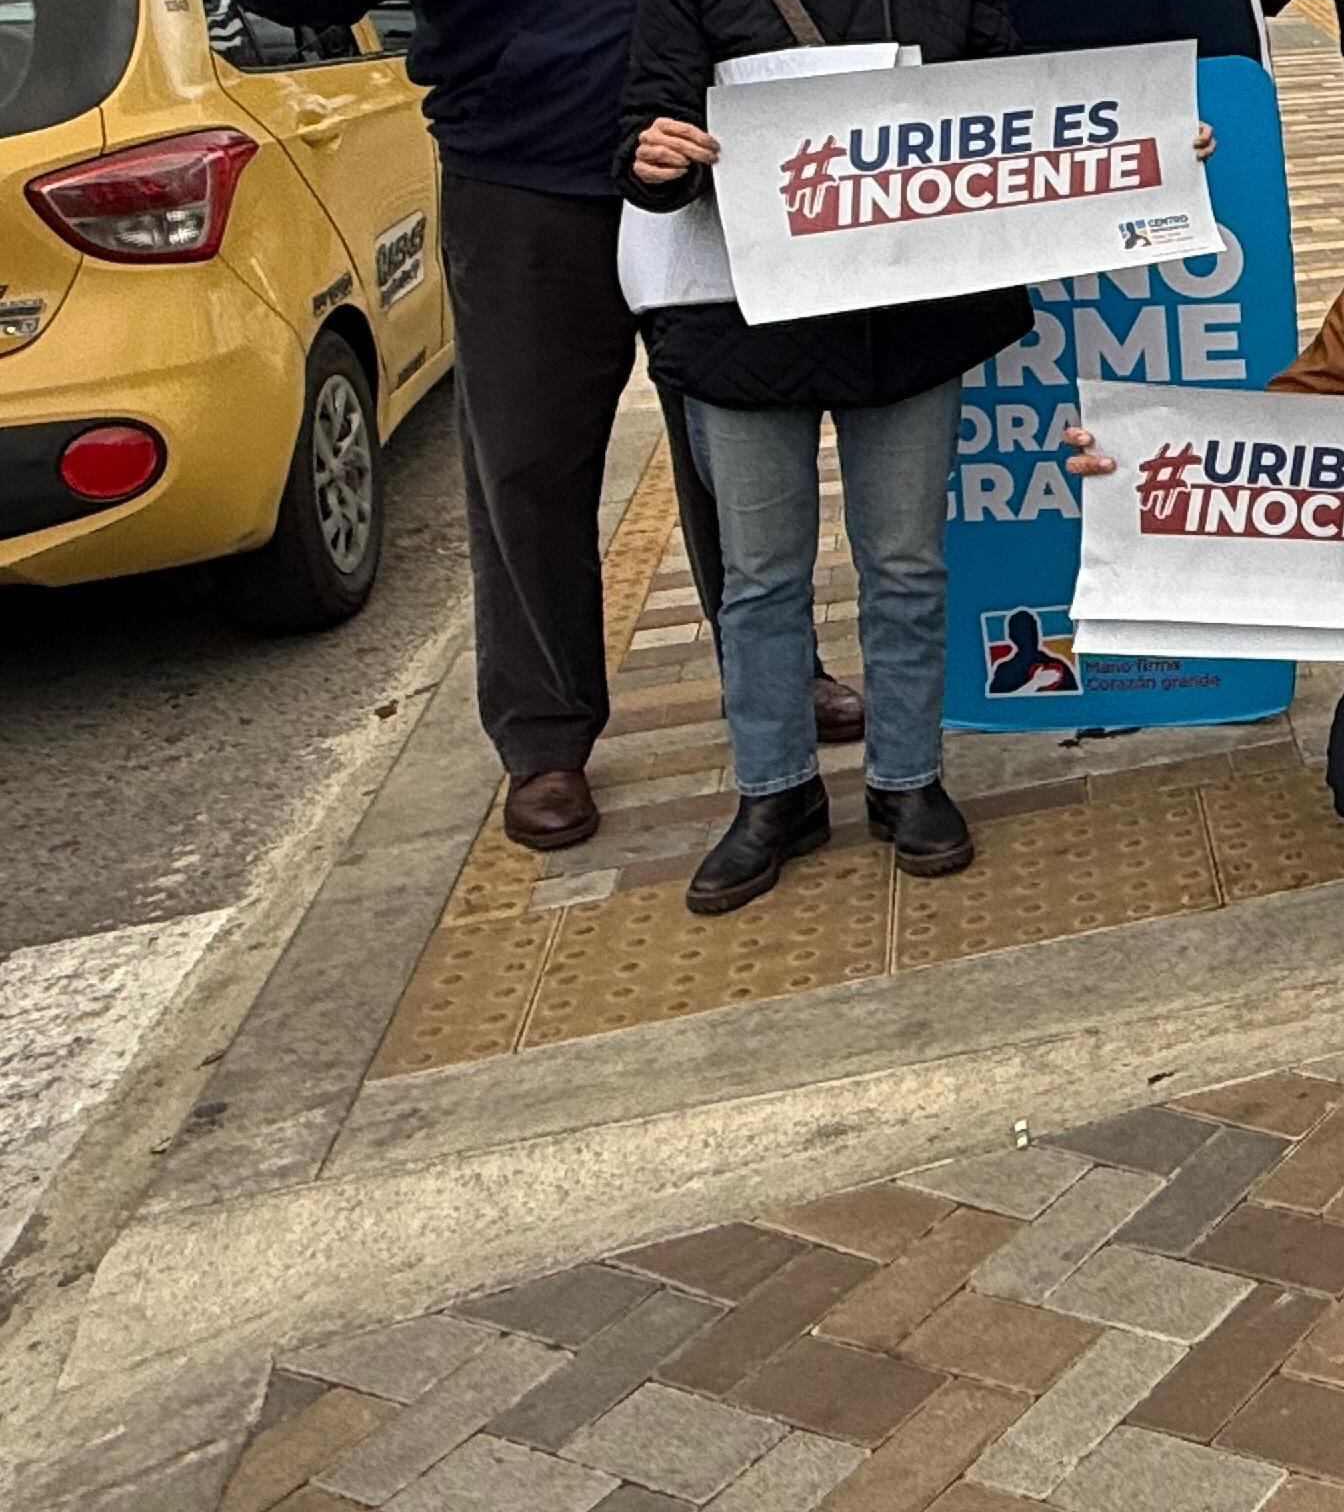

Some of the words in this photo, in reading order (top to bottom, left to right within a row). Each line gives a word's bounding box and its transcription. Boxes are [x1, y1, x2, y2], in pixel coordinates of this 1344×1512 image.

[779, 110, 1033, 213] #URIBE
[1052, 100, 1120, 149] ES
[836, 143, 1142, 226] INOCENTE
